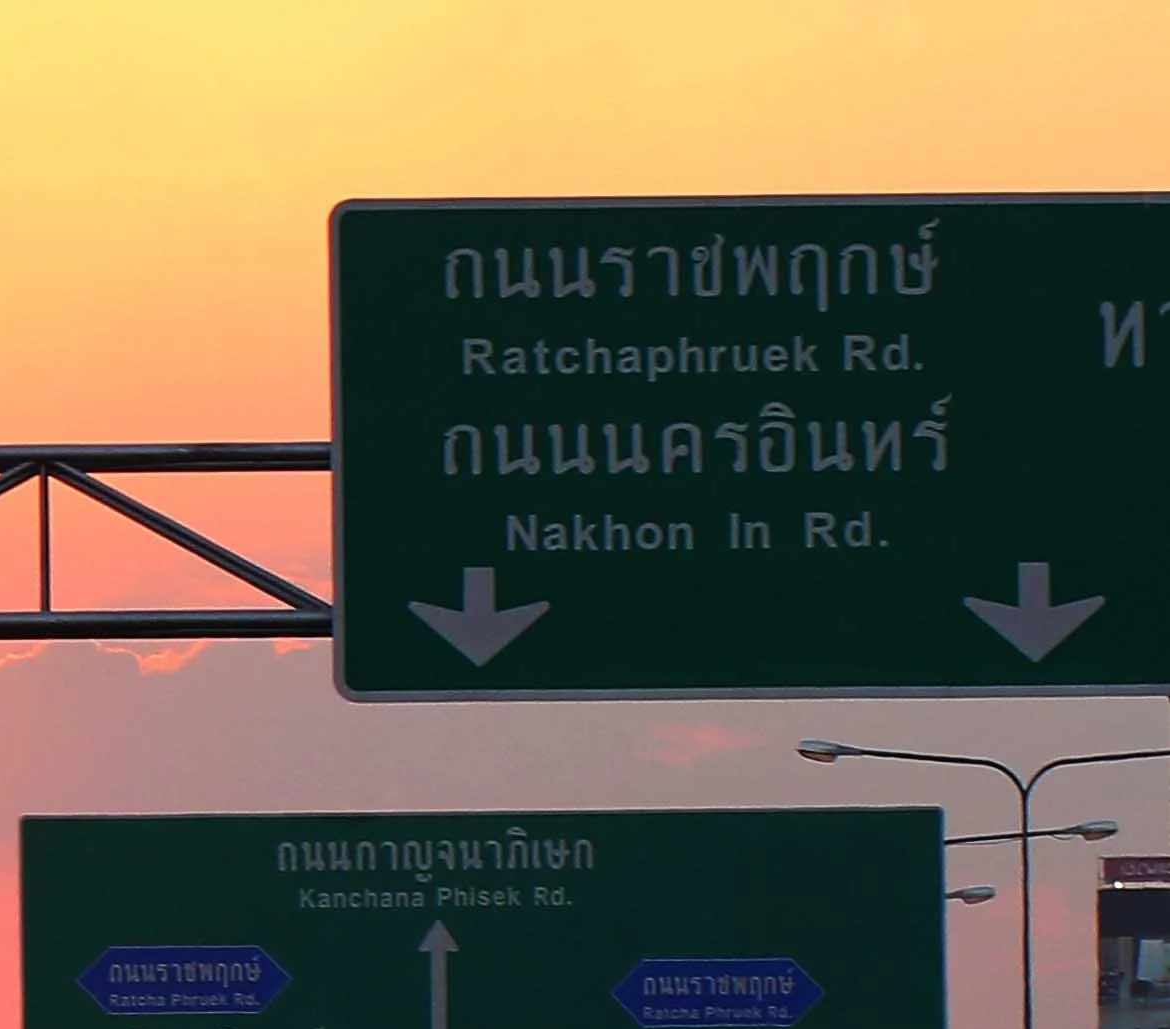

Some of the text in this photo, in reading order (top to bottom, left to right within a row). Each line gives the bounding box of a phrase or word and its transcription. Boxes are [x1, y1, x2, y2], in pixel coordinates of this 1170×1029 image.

[443, 218, 941, 312] ถนนราชพฤกษ์
[462, 334, 925, 384] Ratchaphruek Rd.
[442, 393, 953, 476] ถนนนครอินทร์
[505, 511, 890, 553] Nakhon In Rd.
[276, 825, 596, 884] ถนนกาญจนาภิเษก
[299, 885, 573, 909] Kanchana Phisek Rd.
[107, 954, 263, 988] ถนนราชพฤกษ์
[641, 966, 797, 1001] ถนนราชพฤกษ์
